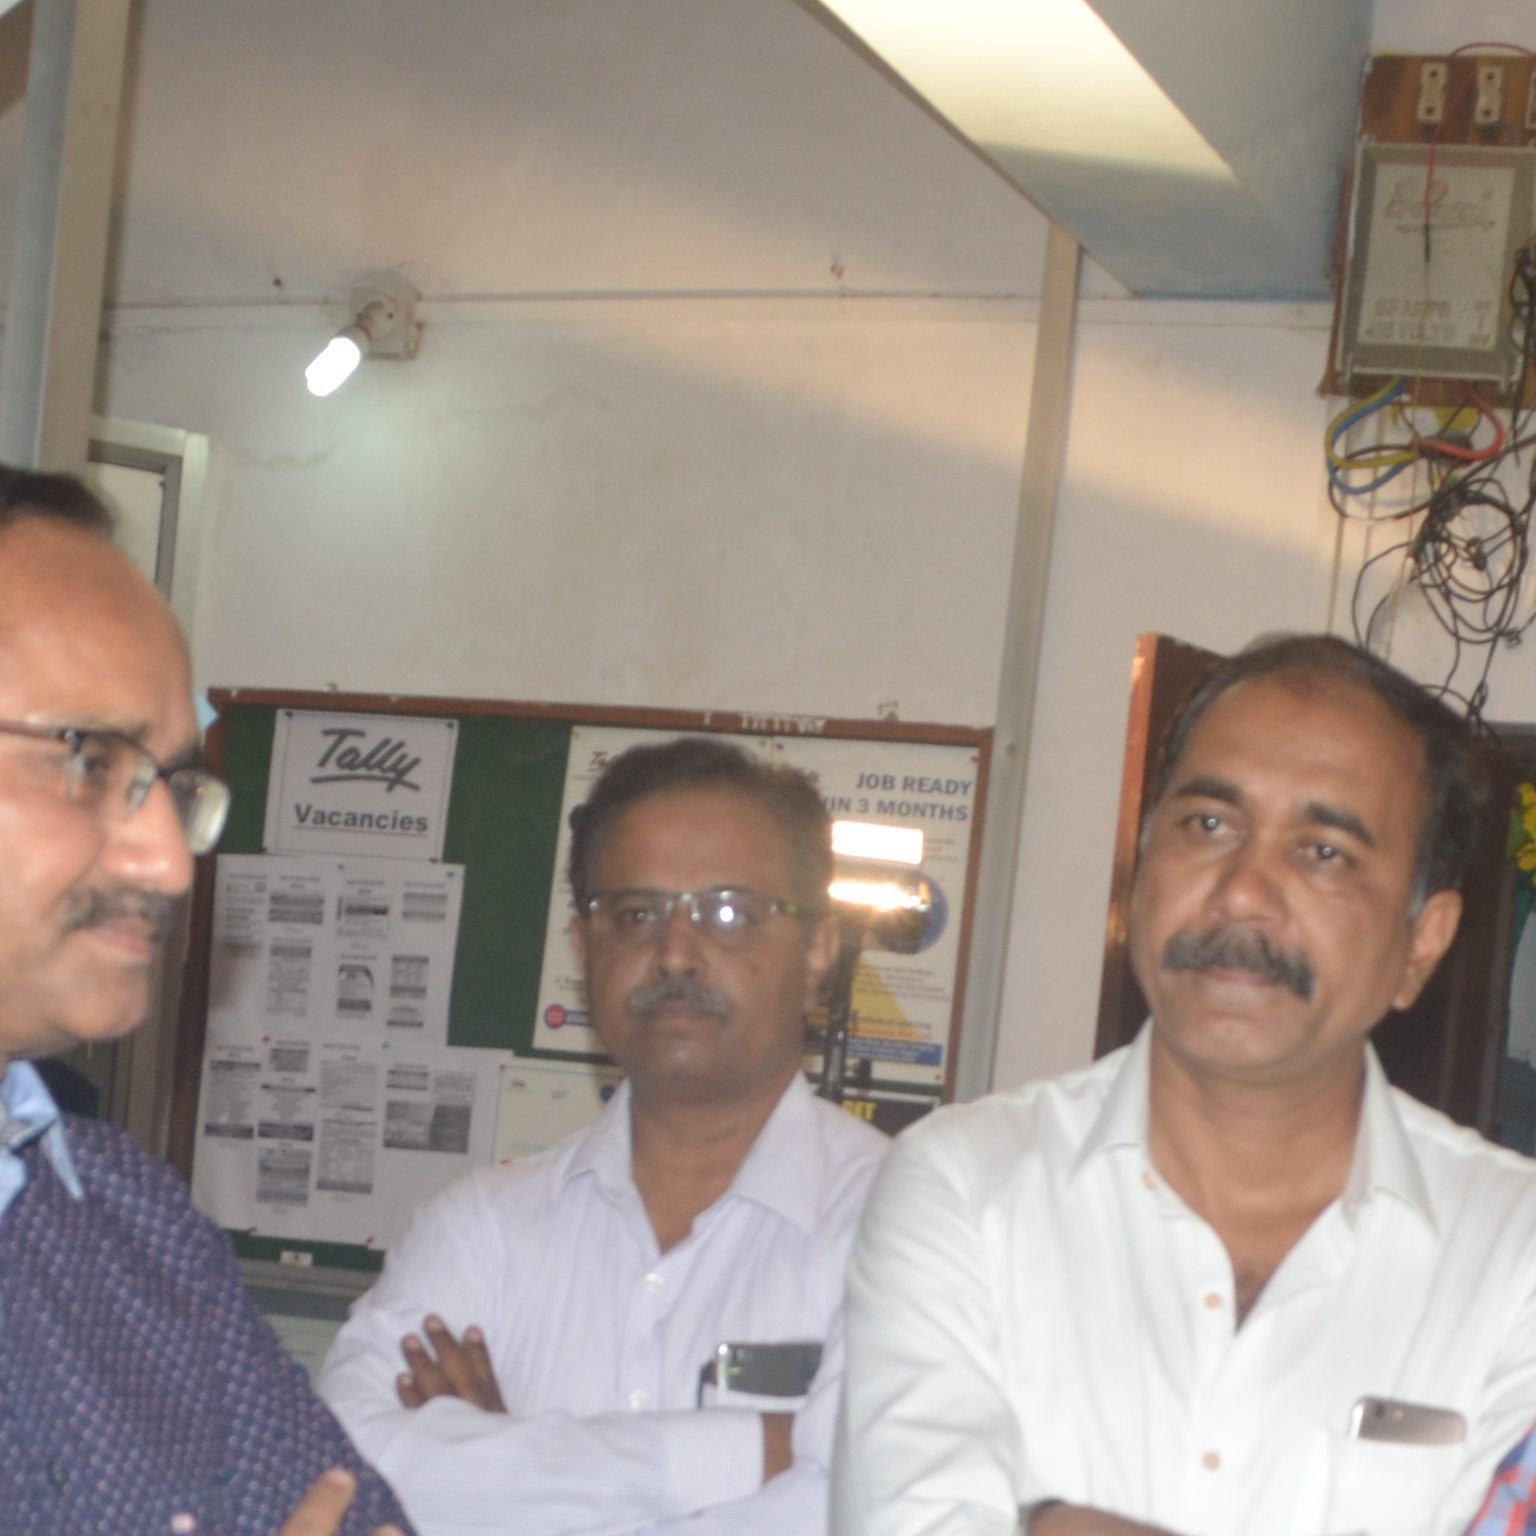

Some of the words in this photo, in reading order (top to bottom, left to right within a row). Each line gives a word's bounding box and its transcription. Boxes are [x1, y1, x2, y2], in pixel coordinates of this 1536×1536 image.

[316, 727, 421, 793] Tally
[856, 772, 896, 791] JOB
[902, 775, 972, 796] READY
[294, 803, 428, 832] Vacancies
[857, 797, 869, 814] 3
[876, 799, 969, 822] MONTHS
